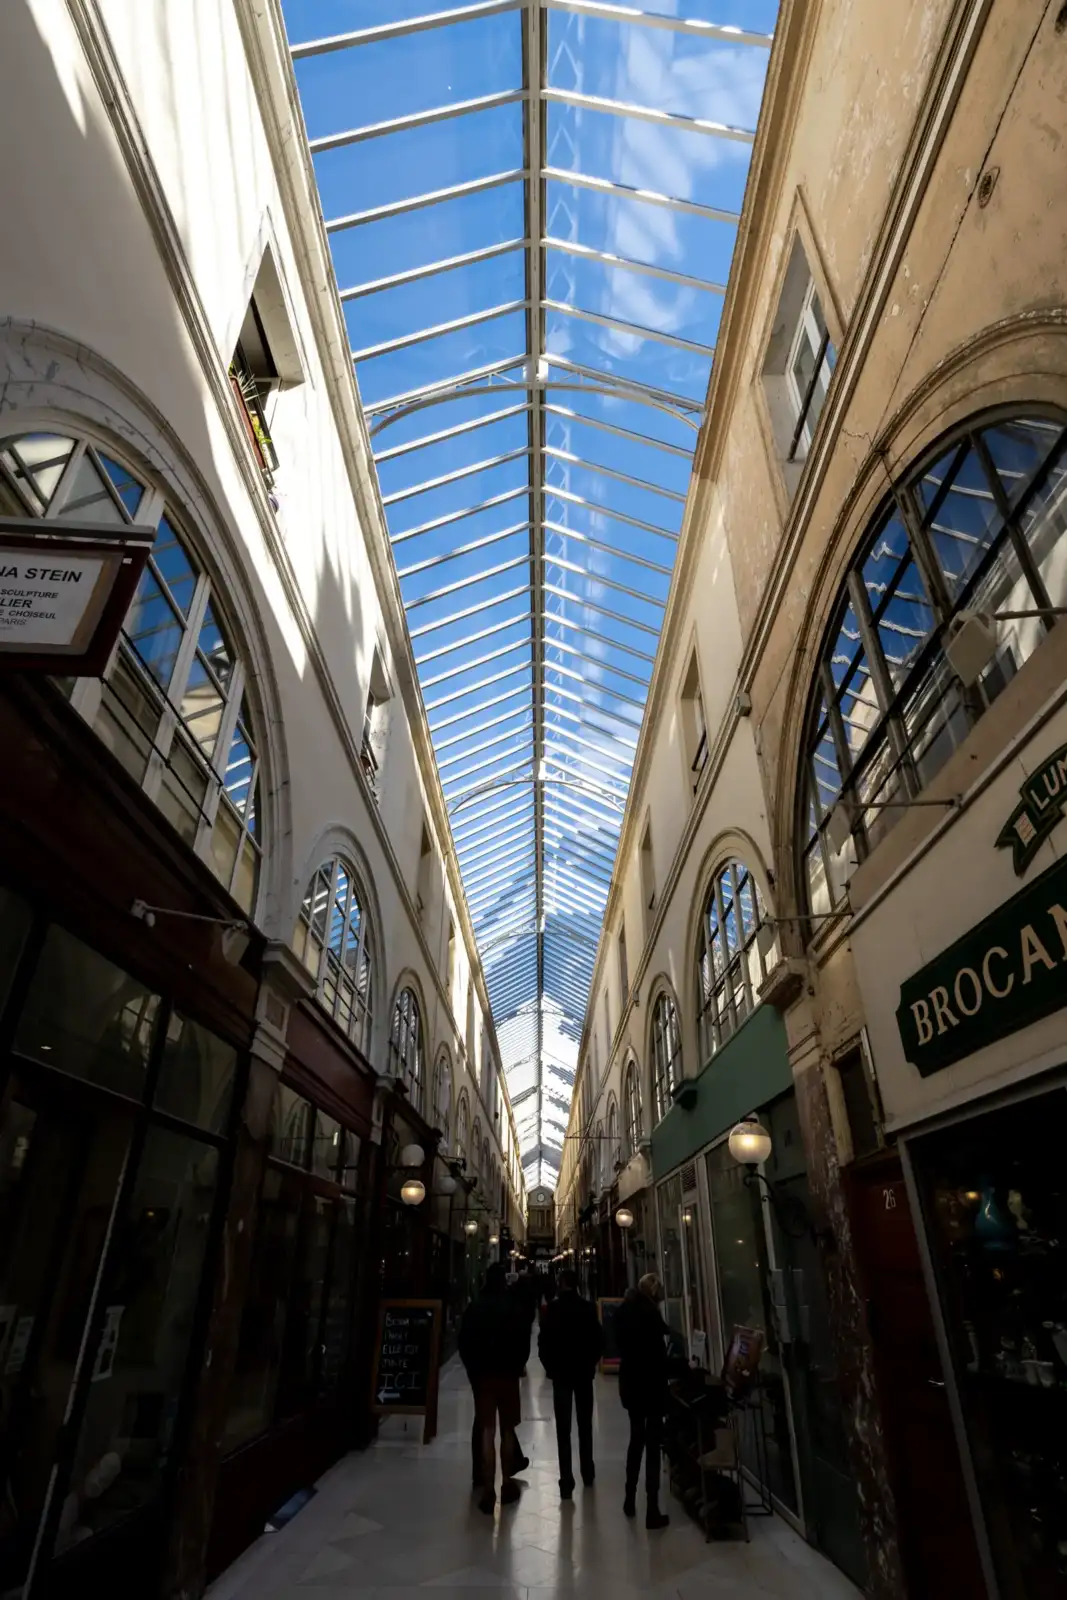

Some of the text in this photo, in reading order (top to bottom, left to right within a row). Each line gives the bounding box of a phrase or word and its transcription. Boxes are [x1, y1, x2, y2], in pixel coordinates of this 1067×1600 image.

[25, 568, 82, 582] STEIN
[0, 589, 59, 599] SCULPTURE
[0, 598, 33, 608] LIER
[9, 610, 56, 620] CHOISEUL
[882, 1188, 897, 1210] 26
[379, 1370, 422, 1390] ICI
